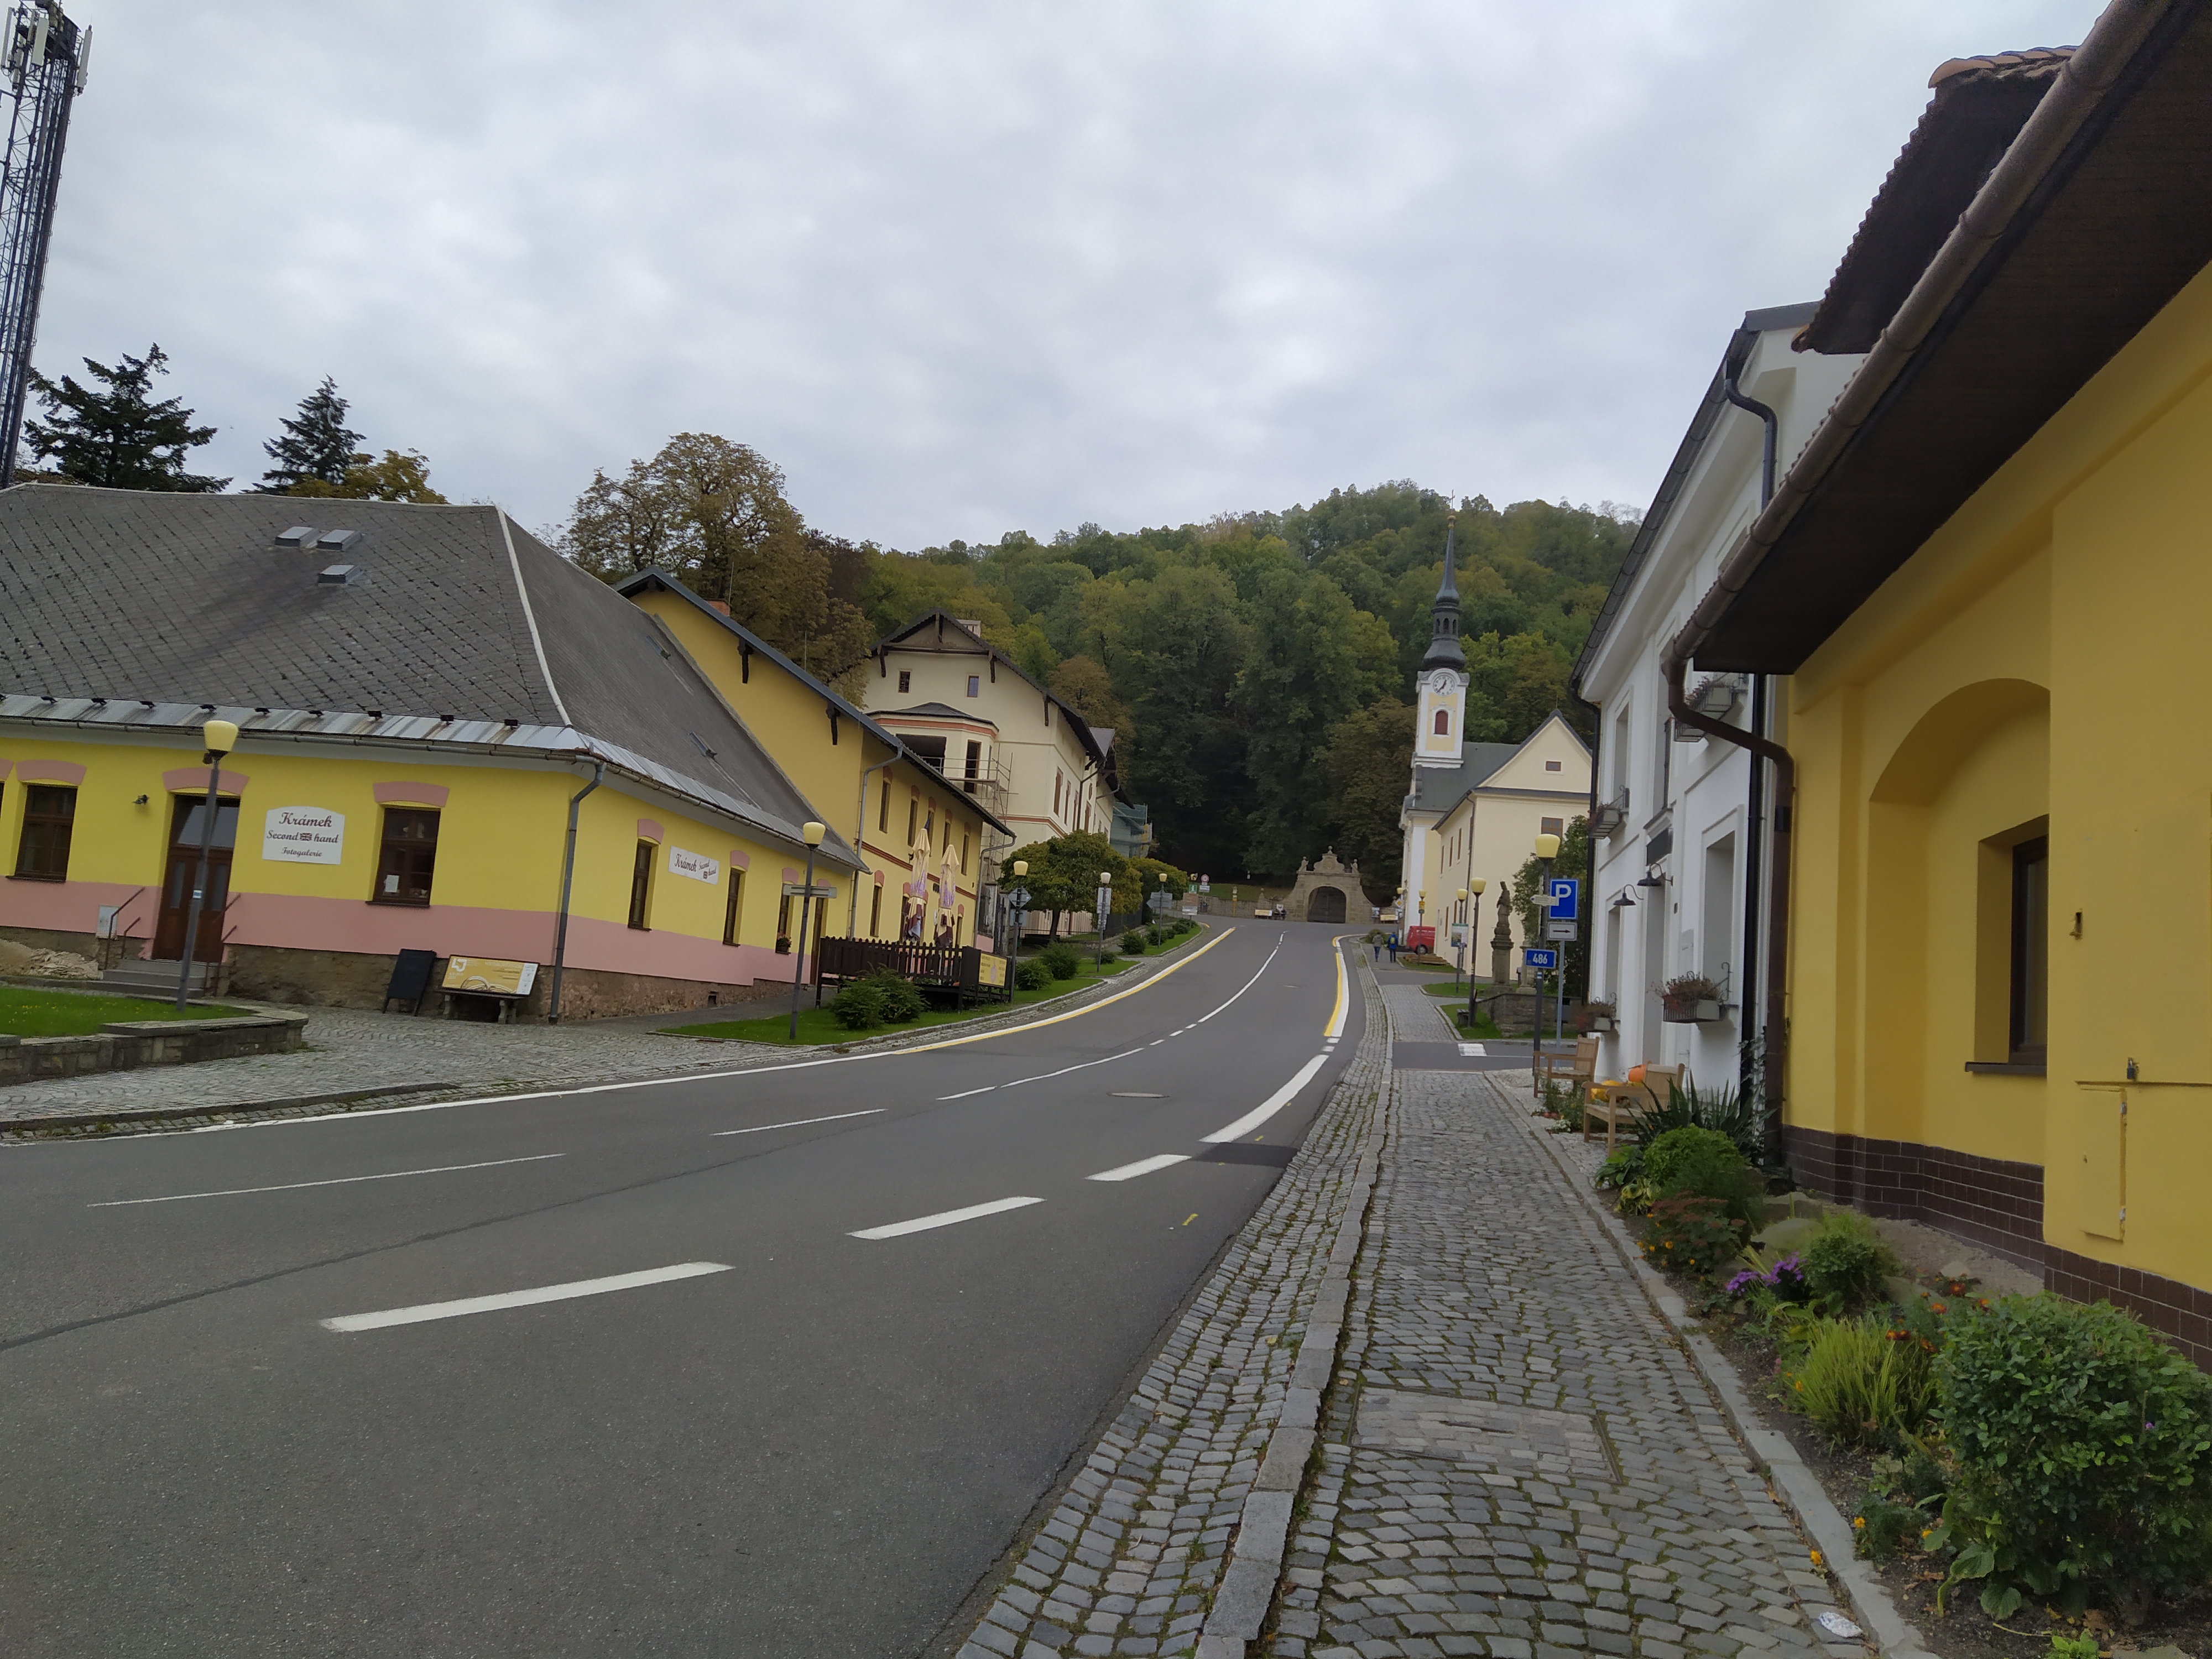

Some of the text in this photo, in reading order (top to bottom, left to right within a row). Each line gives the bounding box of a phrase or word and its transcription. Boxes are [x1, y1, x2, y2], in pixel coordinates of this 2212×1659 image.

[279, 812, 332, 827] Krámek
[267, 830, 338, 843] Second hand
[282, 847, 322, 857] Fotogalerie
[675, 853, 697, 872] Krámek
[1556, 884, 1572, 906] P
[1532, 953, 1548, 964] 486
